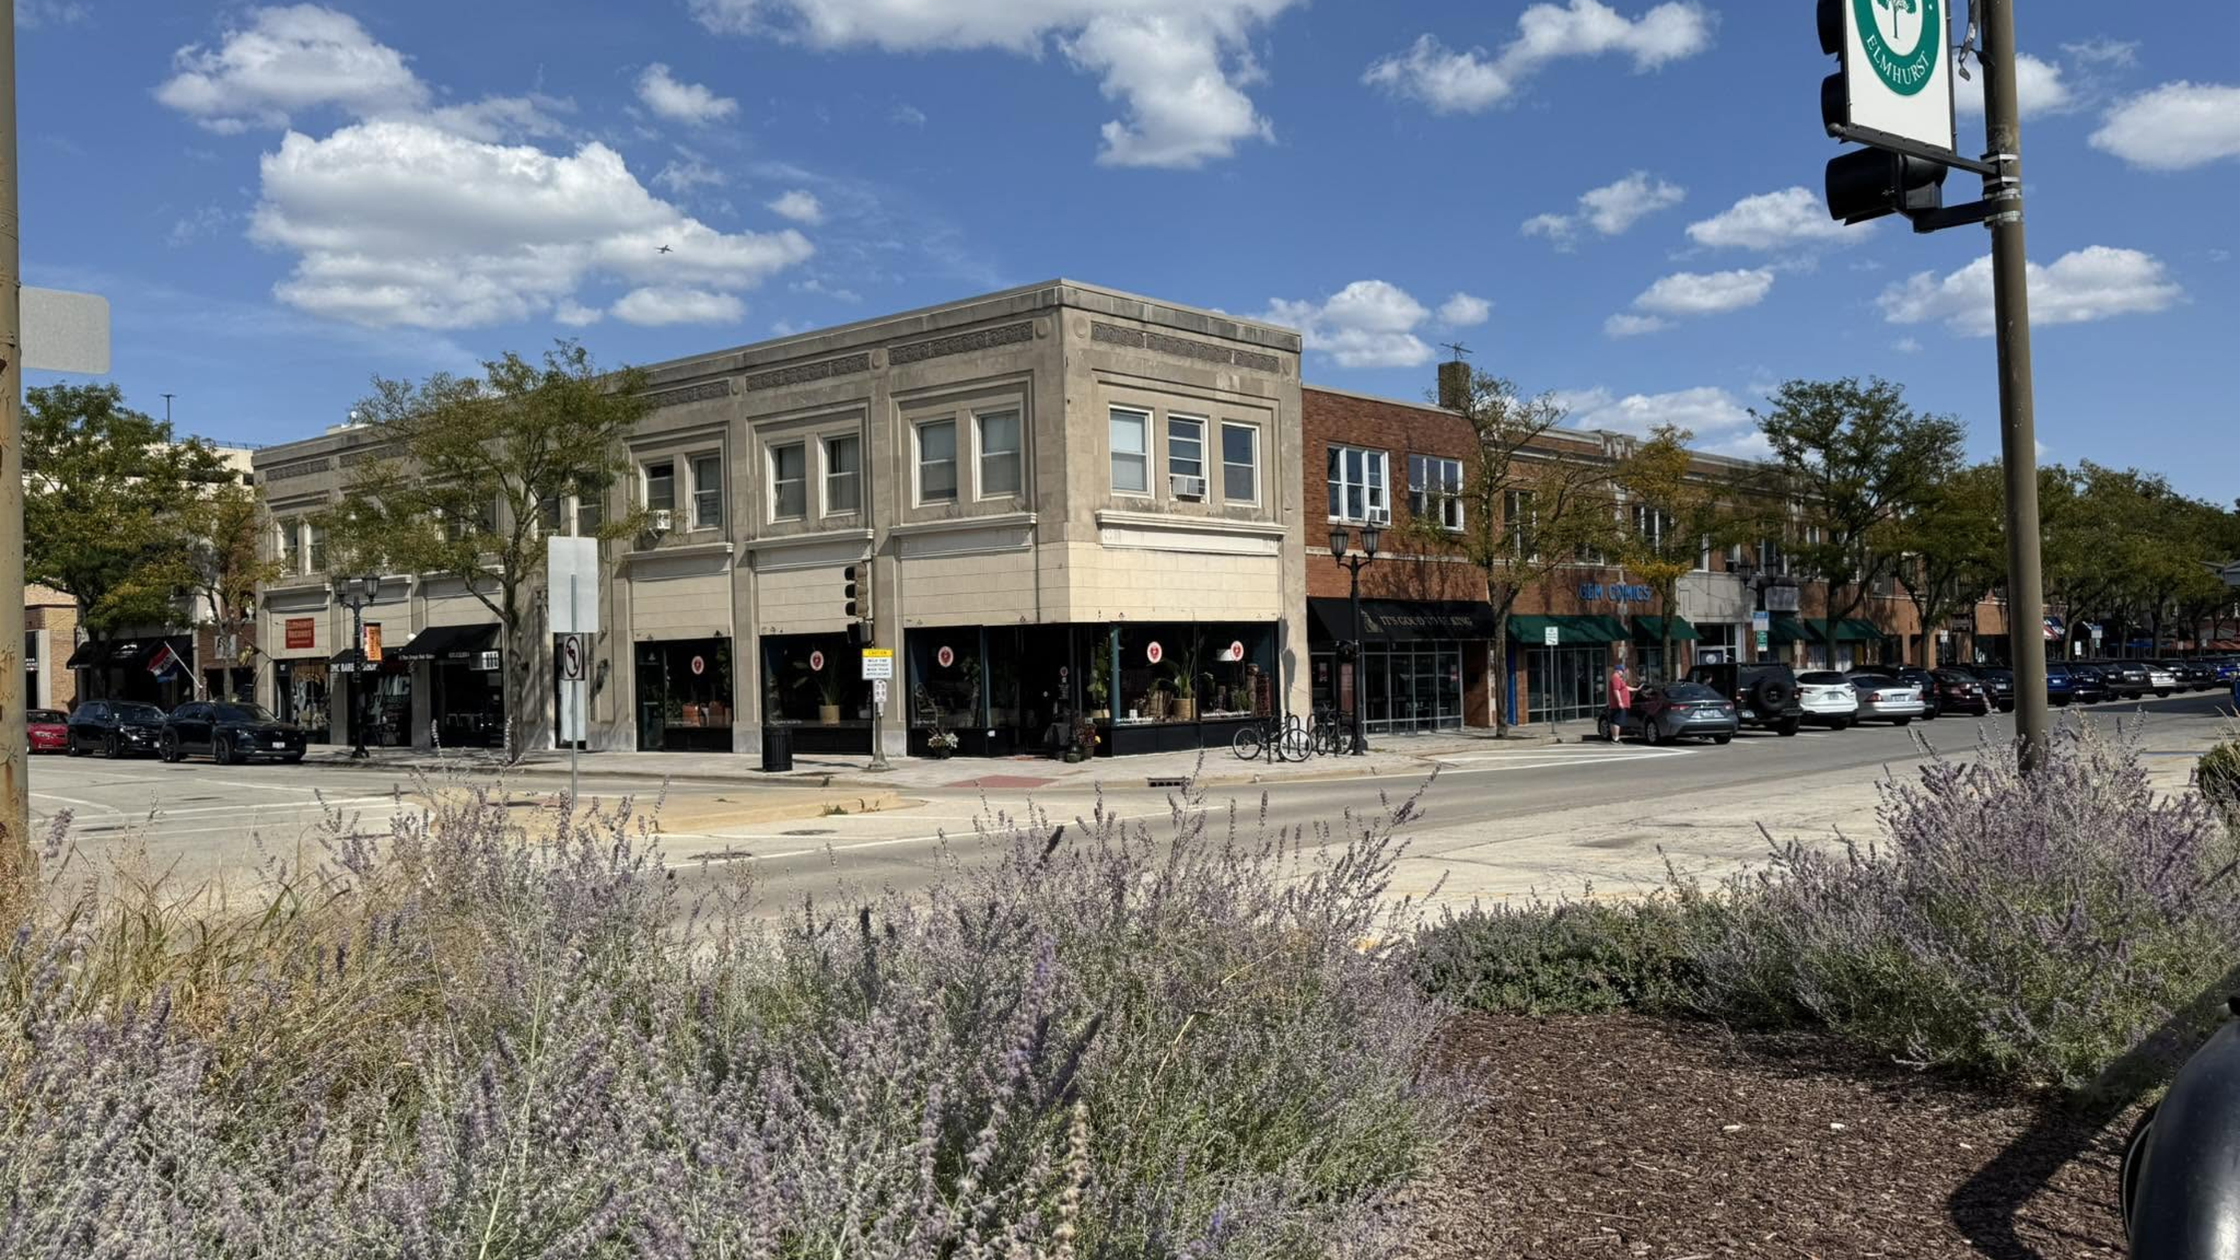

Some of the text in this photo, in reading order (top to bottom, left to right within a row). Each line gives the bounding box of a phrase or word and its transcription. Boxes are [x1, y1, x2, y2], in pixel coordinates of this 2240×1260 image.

[1867, 33, 1929, 85] ELMHURST
[1579, 583, 1651, 602] GEM COMICS
